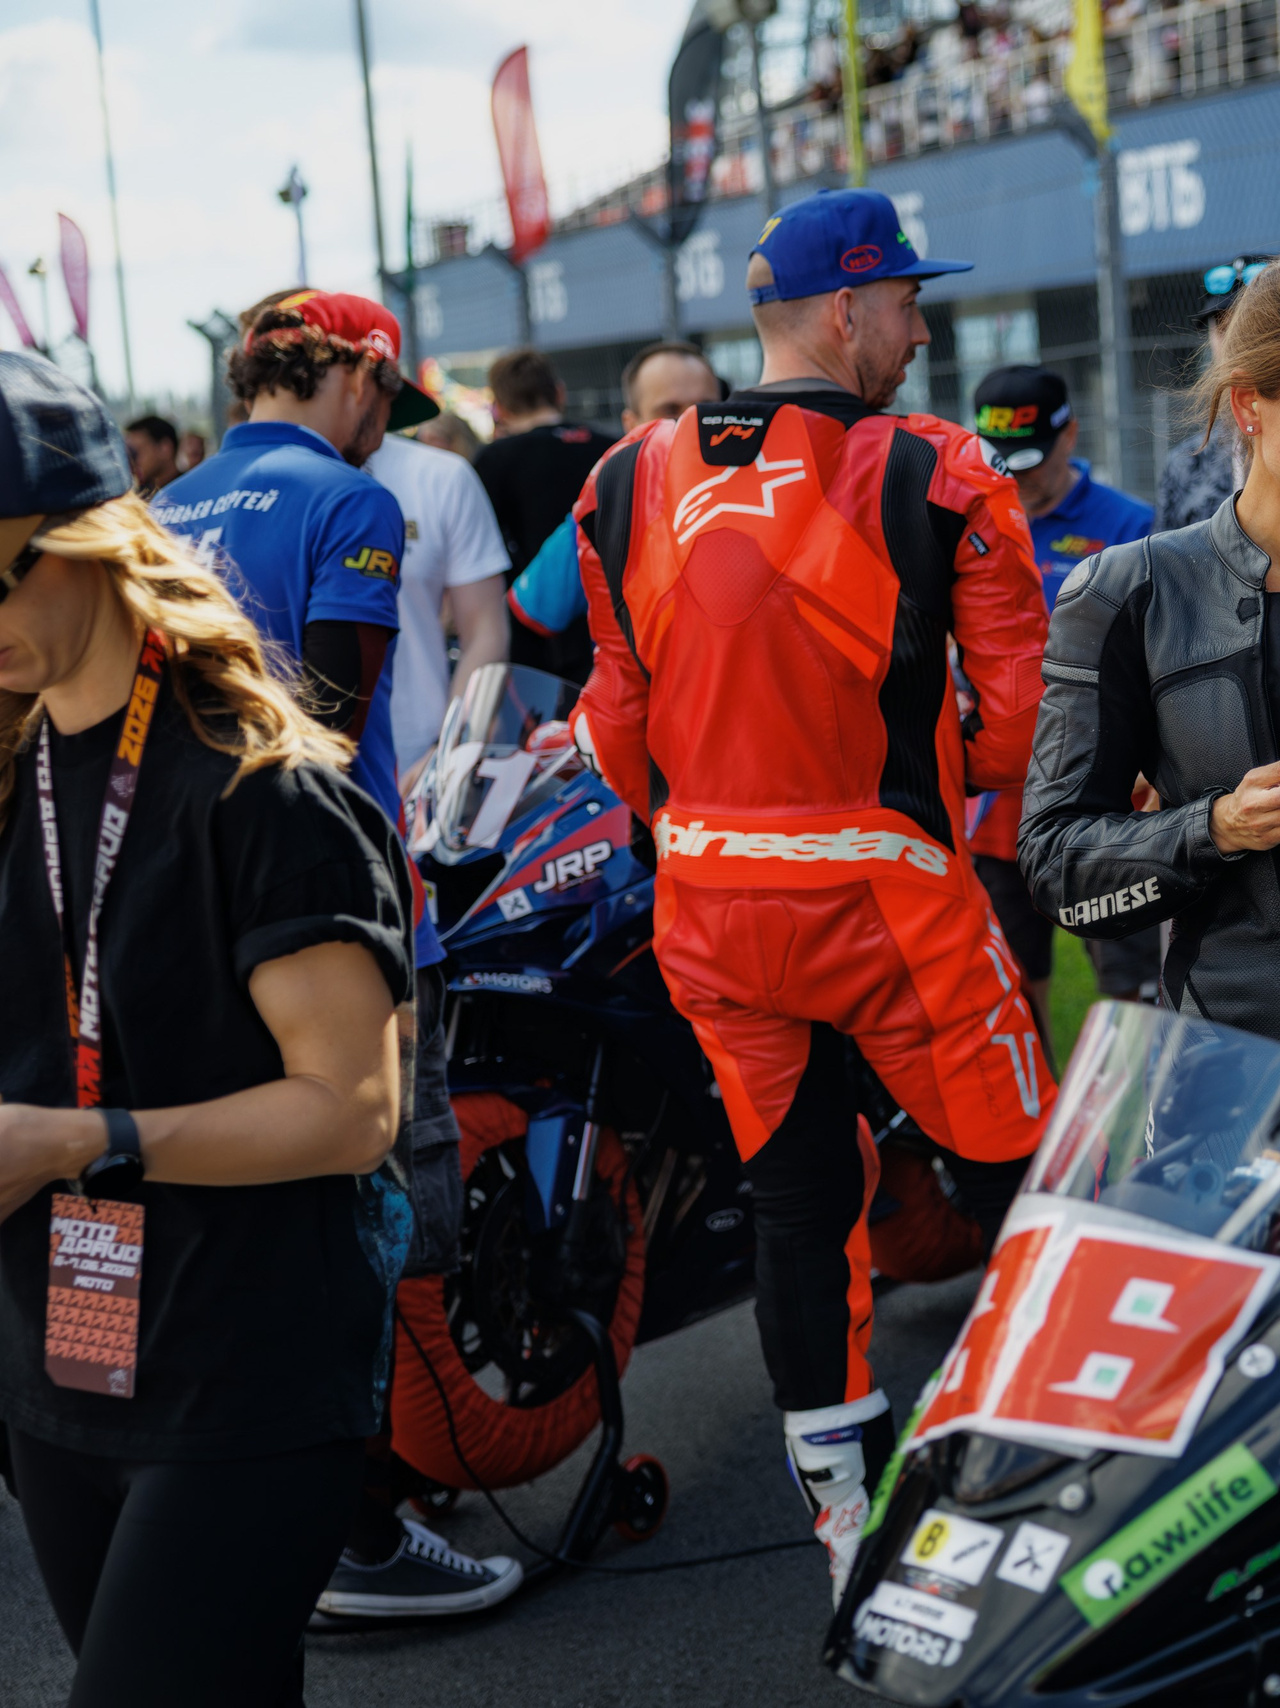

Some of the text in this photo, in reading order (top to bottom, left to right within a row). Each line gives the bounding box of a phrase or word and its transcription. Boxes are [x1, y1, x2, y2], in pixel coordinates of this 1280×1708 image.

[1117, 137, 1206, 238] ВТБ
[533, 840, 612, 893] JRP
[1058, 875, 1162, 926] DAINESE
[51, 1216, 118, 1242] МОТО
[73, 1274, 115, 1292] МОТО
[1103, 1475, 1254, 1599] r.a.w.life
